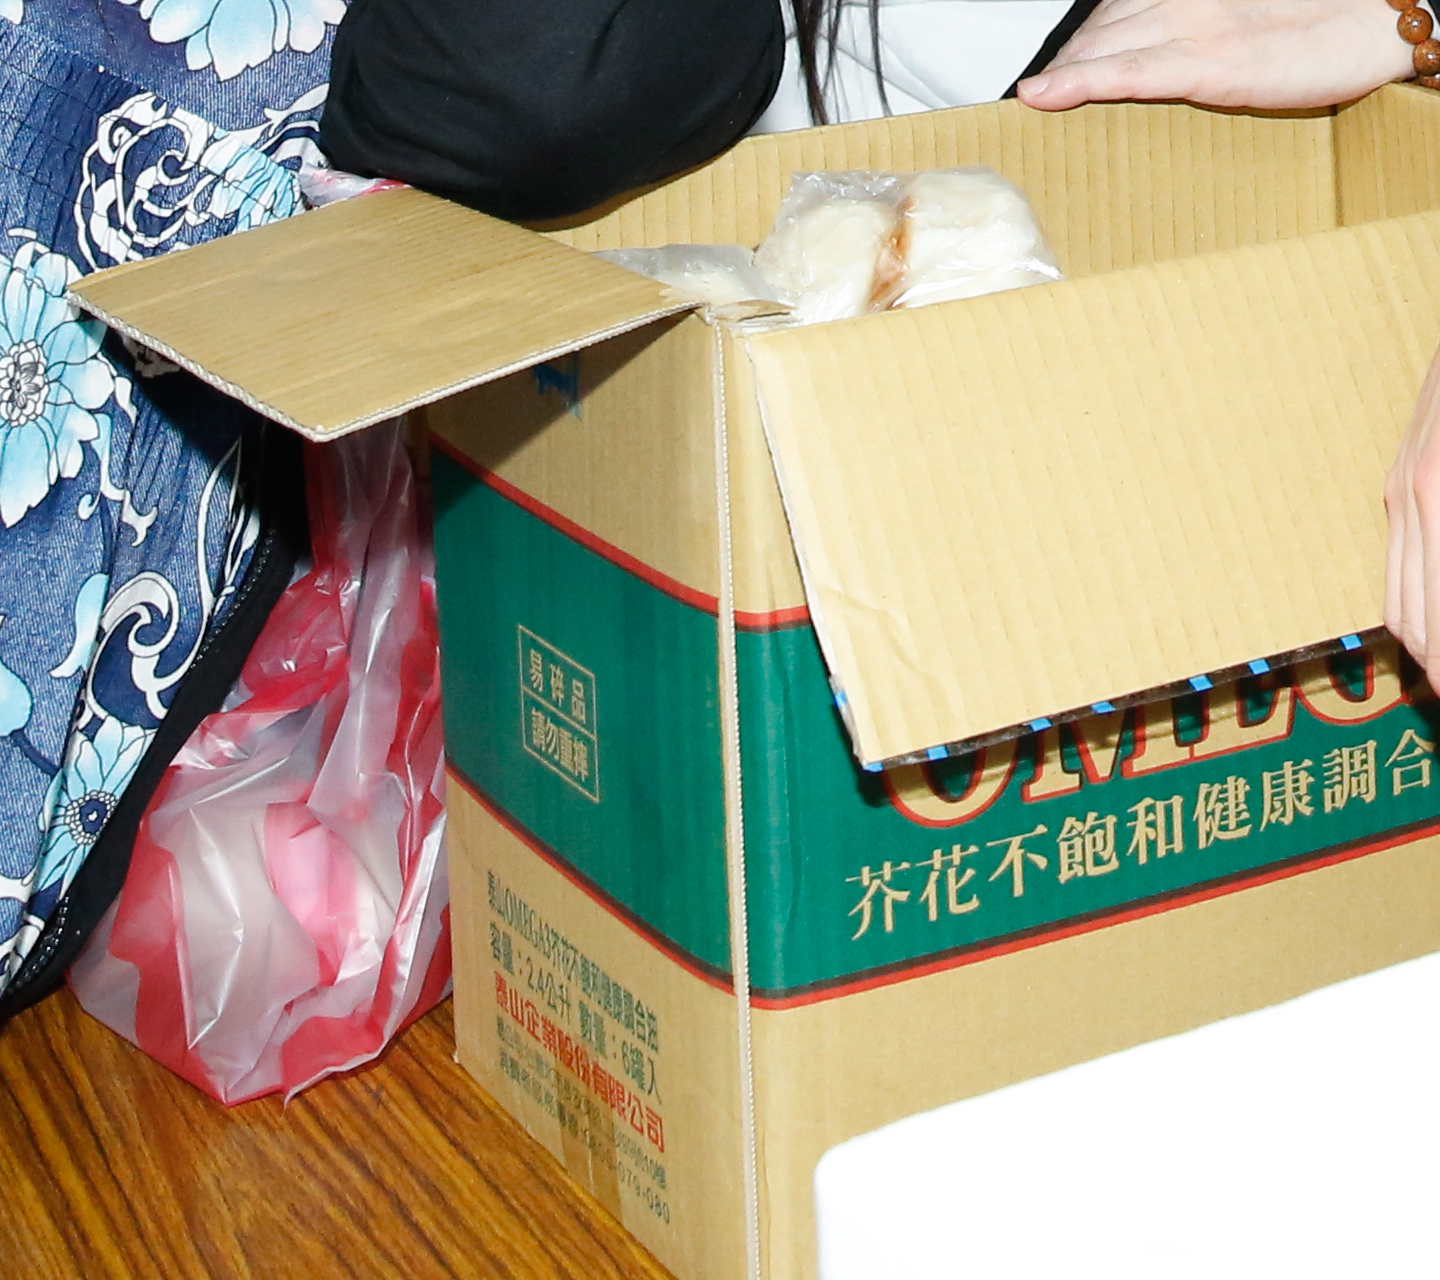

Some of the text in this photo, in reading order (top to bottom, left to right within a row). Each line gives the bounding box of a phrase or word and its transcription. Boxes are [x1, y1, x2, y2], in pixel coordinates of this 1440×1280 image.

[530, 649, 586, 724] 易碎品
[494, 971, 666, 1154] 泰山企業股份有限公司
